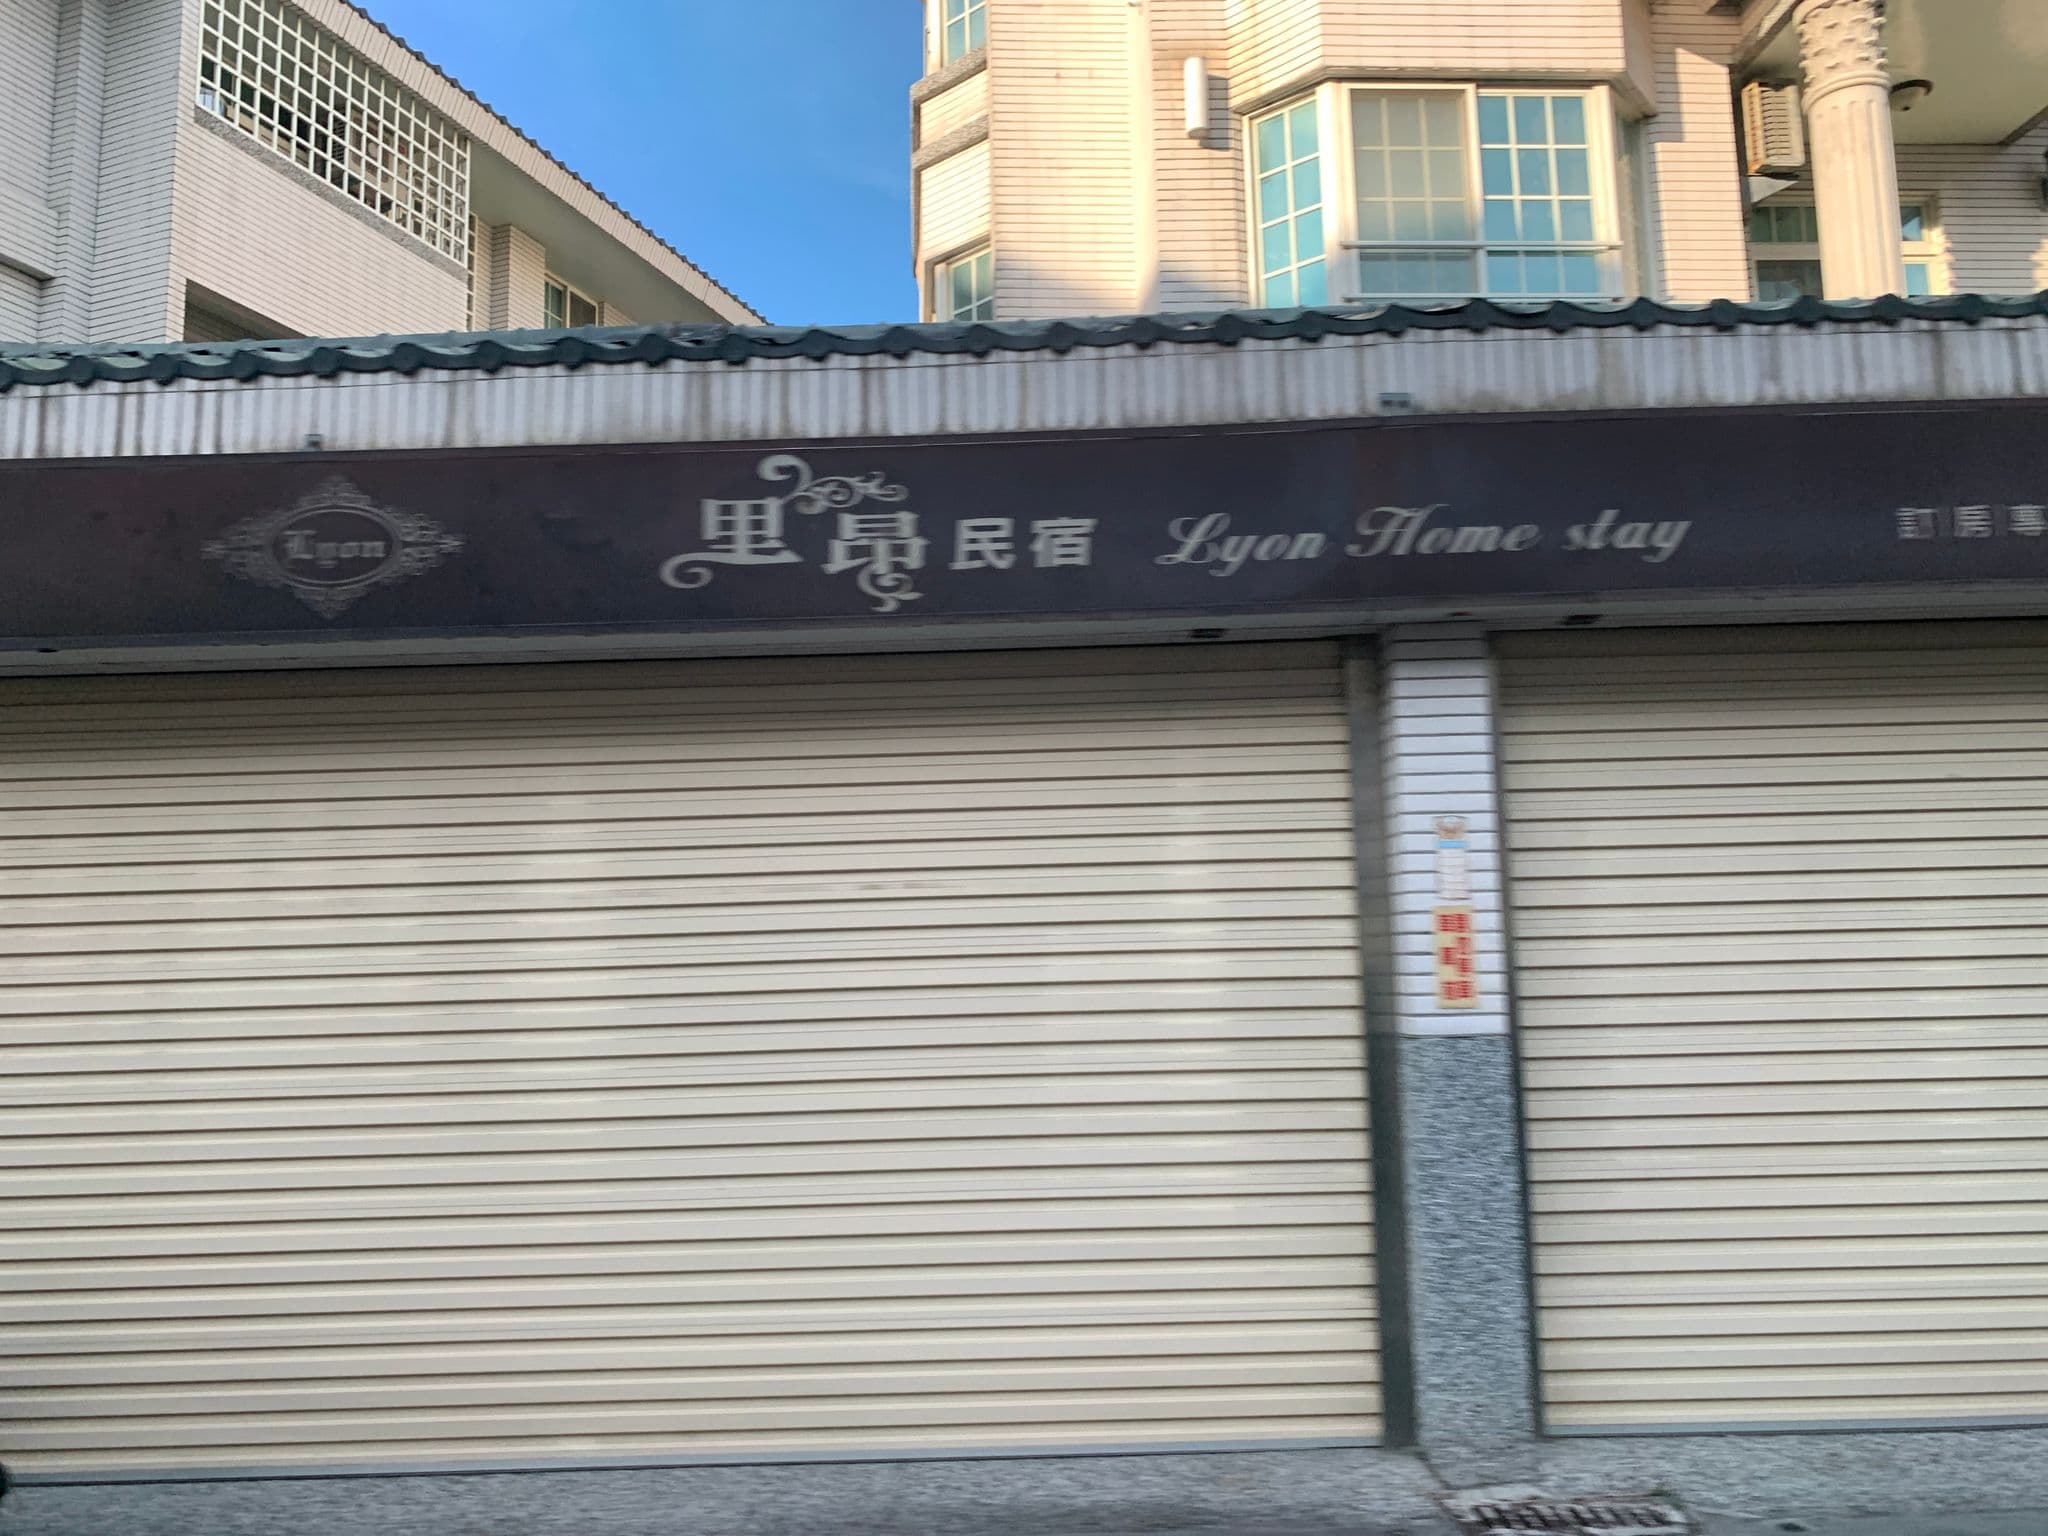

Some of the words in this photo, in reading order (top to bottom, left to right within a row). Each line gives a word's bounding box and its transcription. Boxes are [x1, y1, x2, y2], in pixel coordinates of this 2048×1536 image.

[661, 480, 1098, 608] 里昂民宿
[1154, 512, 1328, 577] Lyon
[1345, 503, 1541, 557] Home
[1563, 508, 1694, 563] stay
